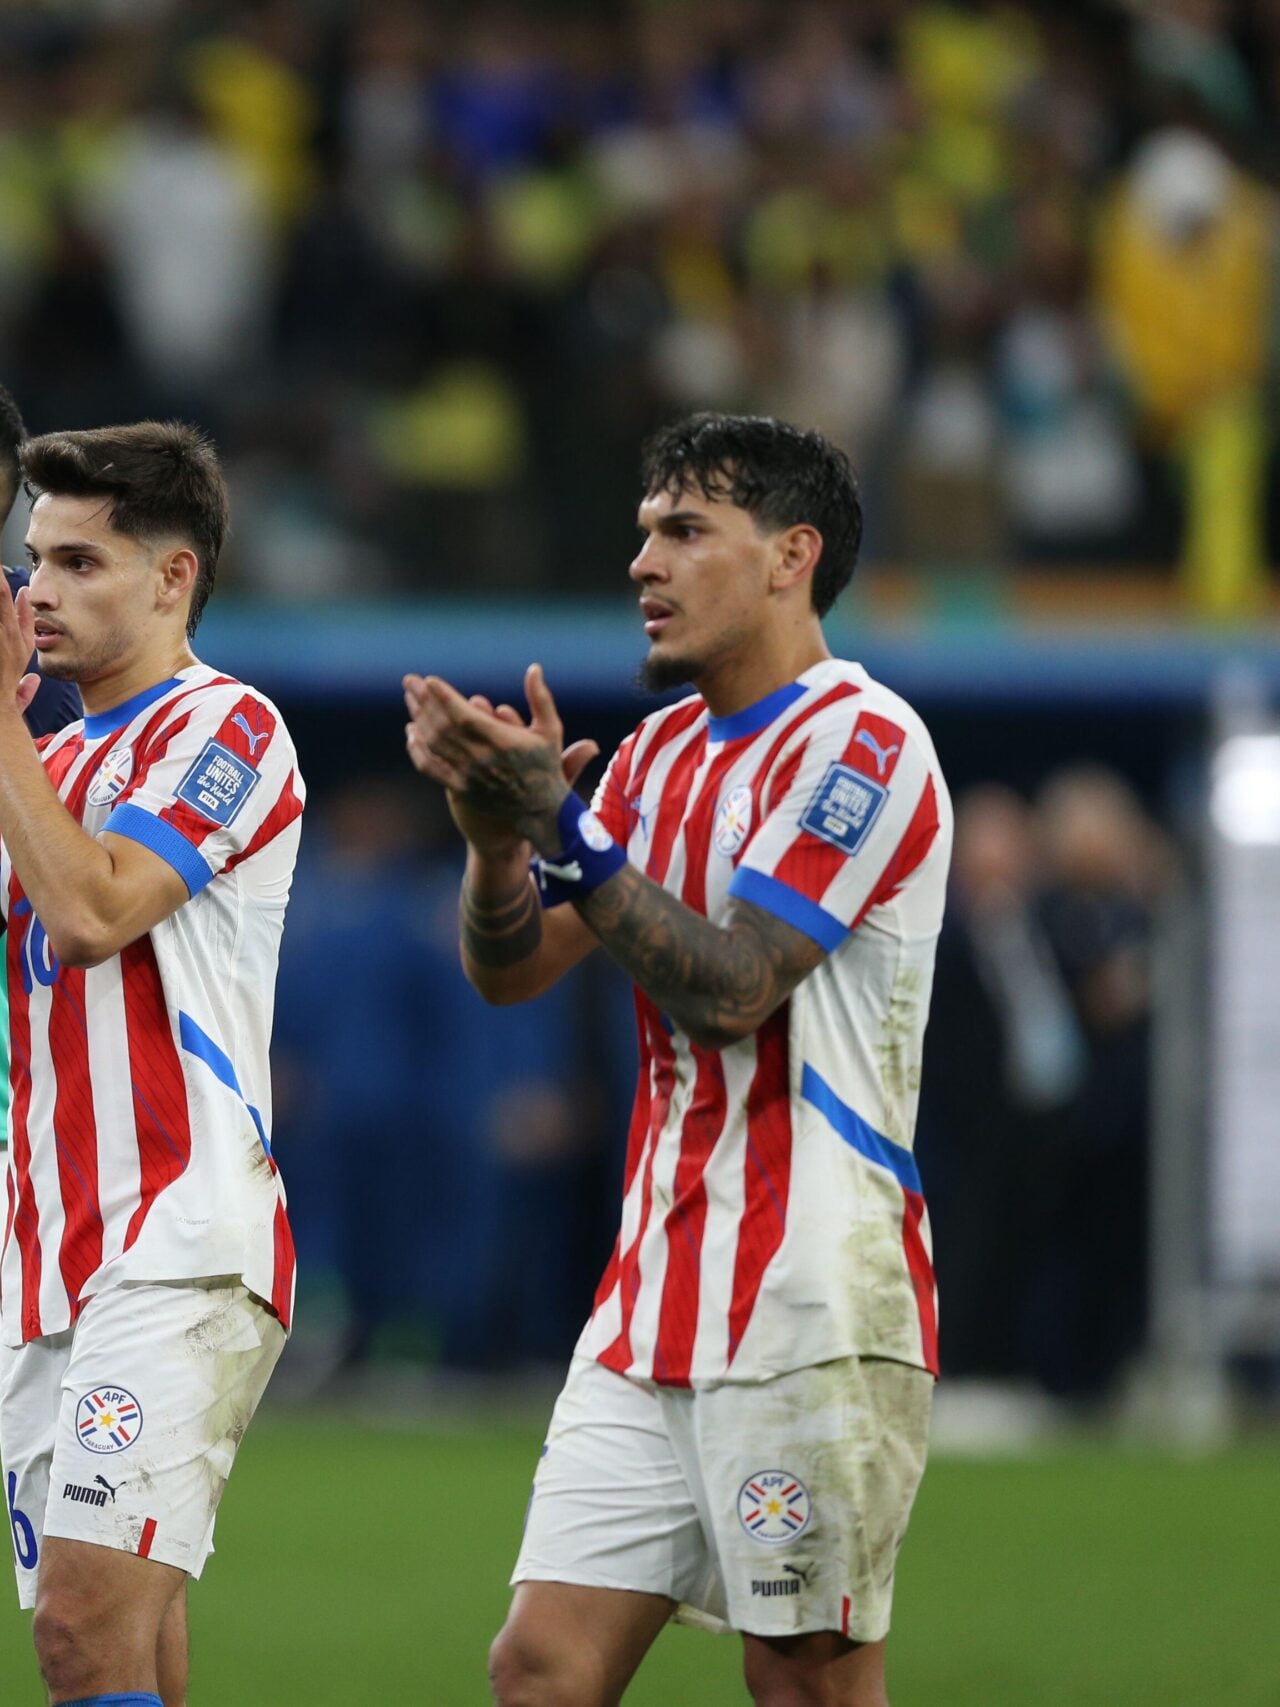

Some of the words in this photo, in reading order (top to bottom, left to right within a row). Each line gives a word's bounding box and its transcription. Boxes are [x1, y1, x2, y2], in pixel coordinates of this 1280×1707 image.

[205, 763, 240, 795] UNITES
[212, 754, 244, 785] FOOTBALL
[196, 774, 211, 789] the
[209, 782, 235, 806] World
[102, 1391, 127, 1404] APF
[84, 1437, 115, 1450] PARAGUAY
[62, 1483, 108, 1507] PUMA
[751, 1579, 800, 1597] PUMA
